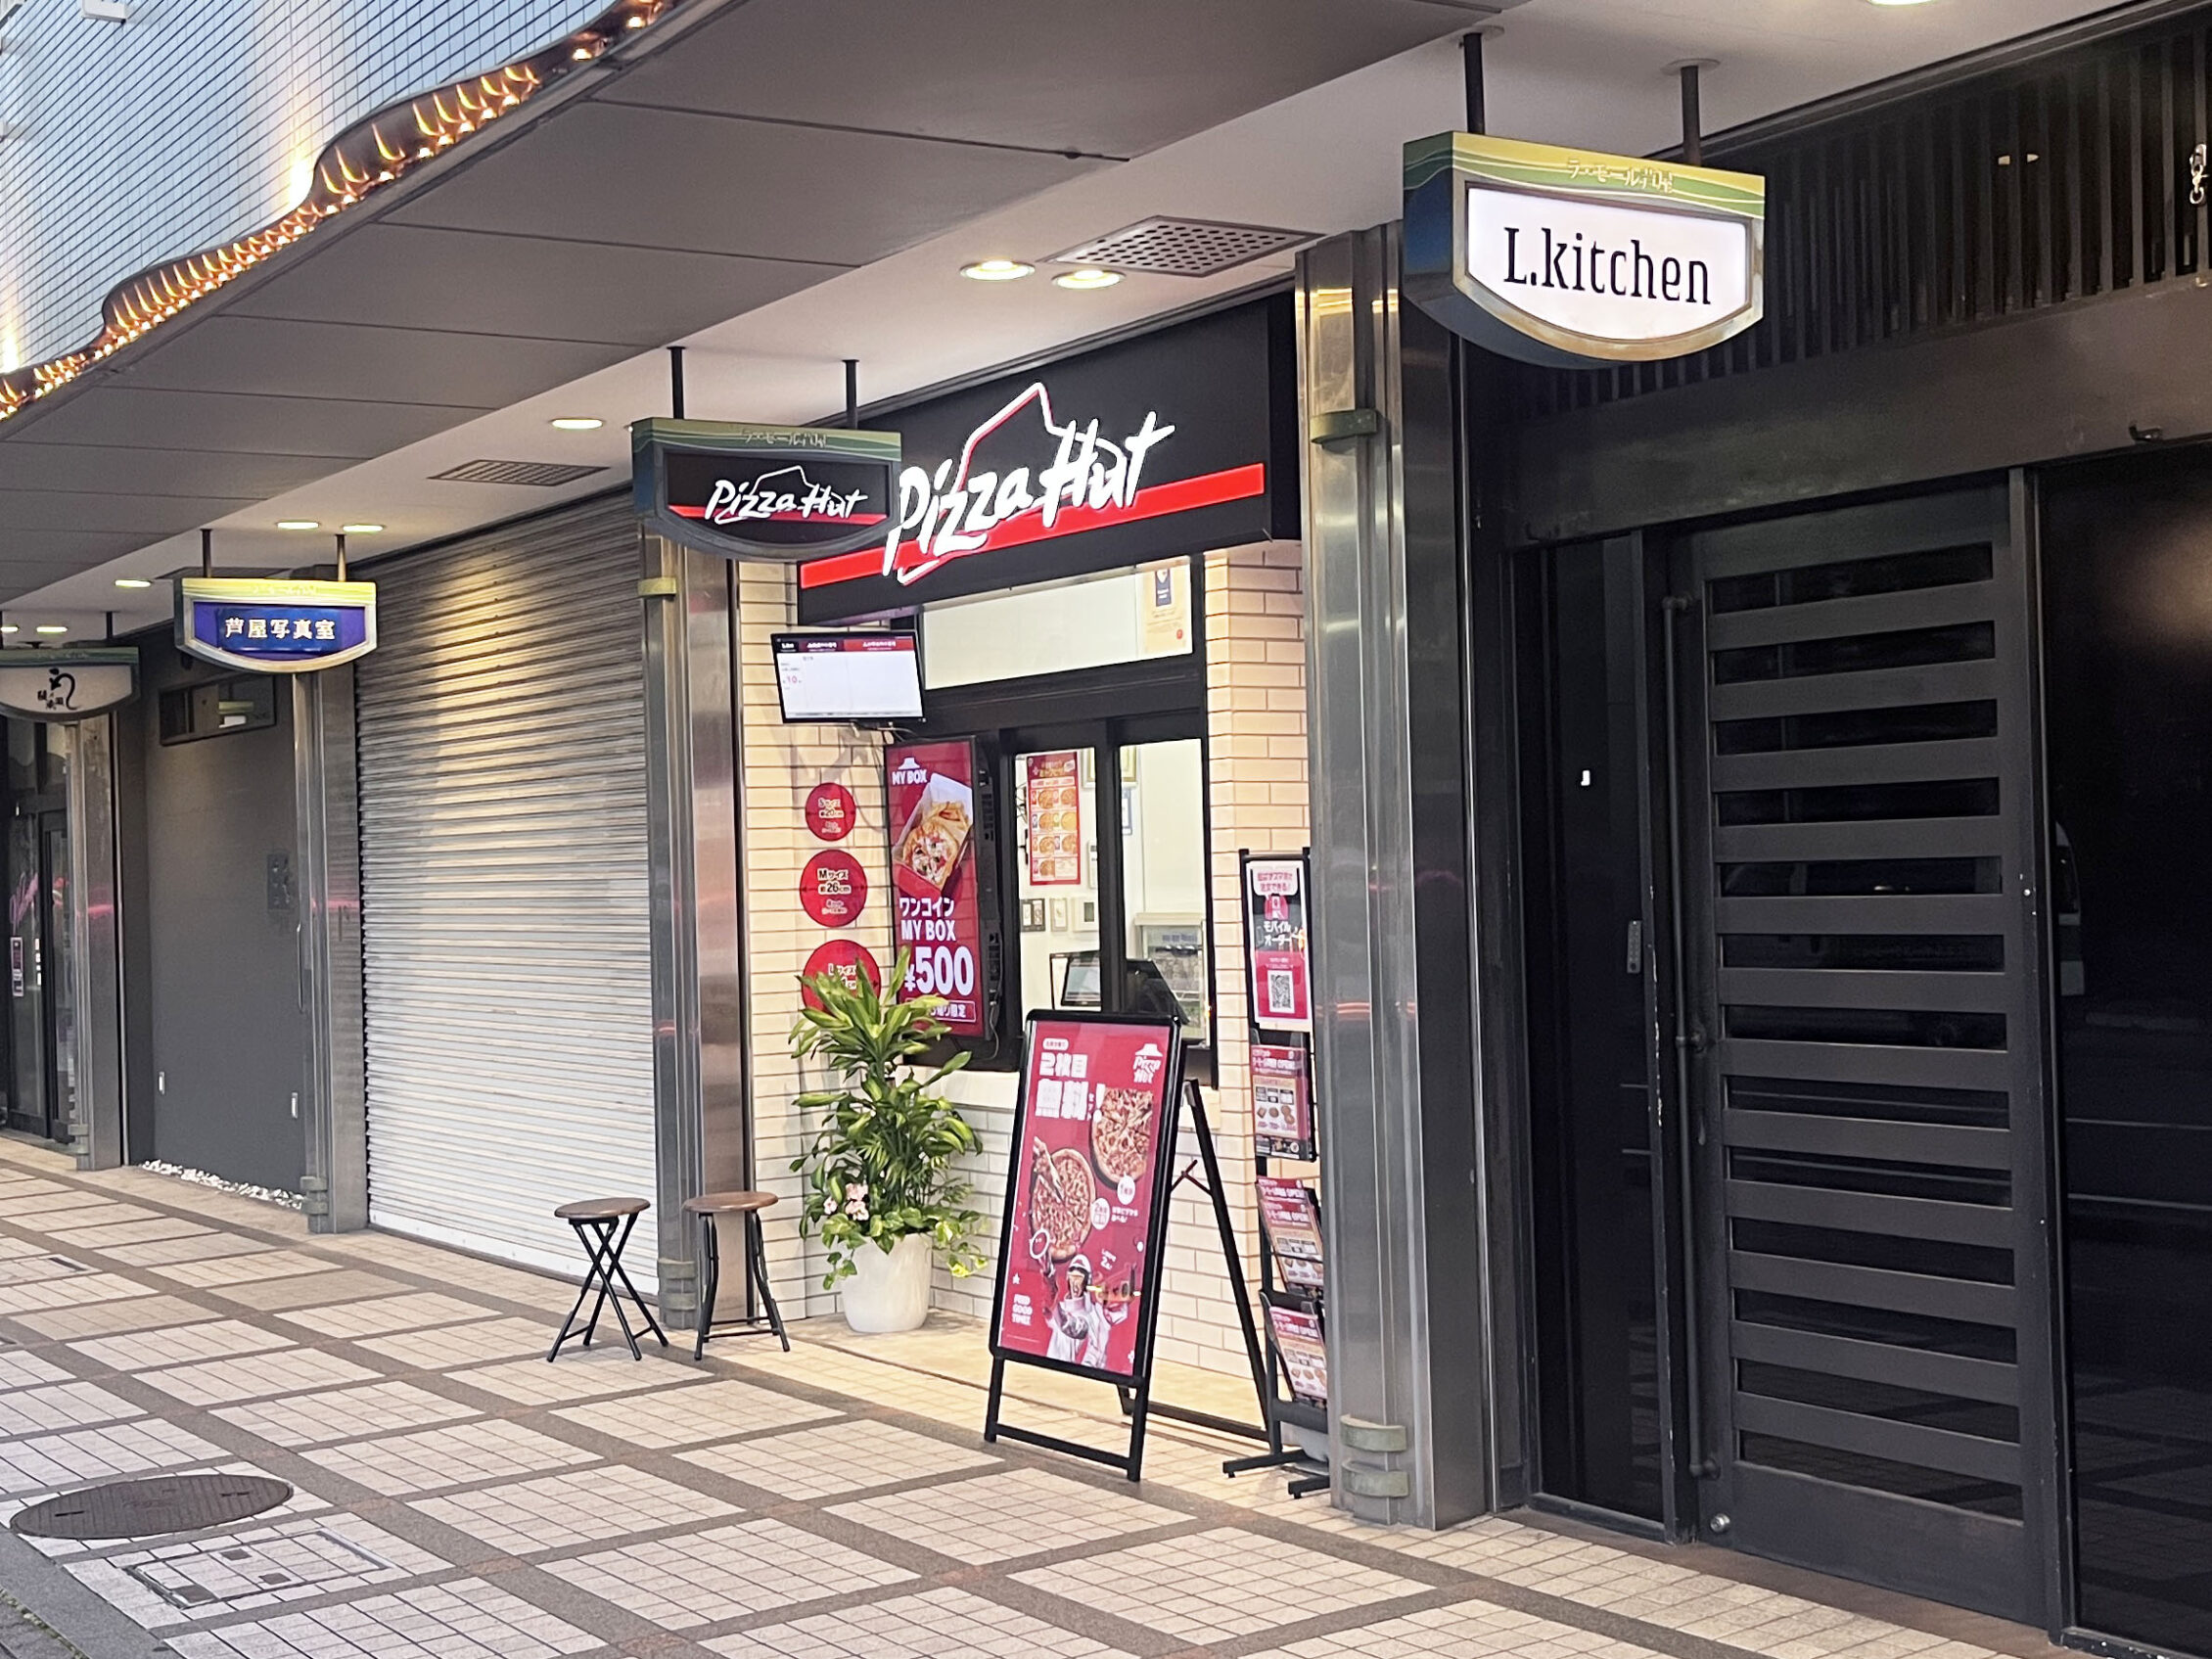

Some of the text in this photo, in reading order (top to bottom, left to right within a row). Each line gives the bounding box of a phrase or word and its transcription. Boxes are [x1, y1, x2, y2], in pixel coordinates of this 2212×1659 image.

[1503, 226, 1711, 304] L.kitchen
[704, 479, 869, 526] Pizza Hut
[882, 410, 1175, 585] Pizza Hut
[224, 617, 336, 641] 芦屋写真室
[892, 768, 928, 786] MY BOX
[818, 868, 850, 880] Mサイズ
[899, 897, 955, 918] ワンコイン
[900, 919, 956, 942] MY BOX
